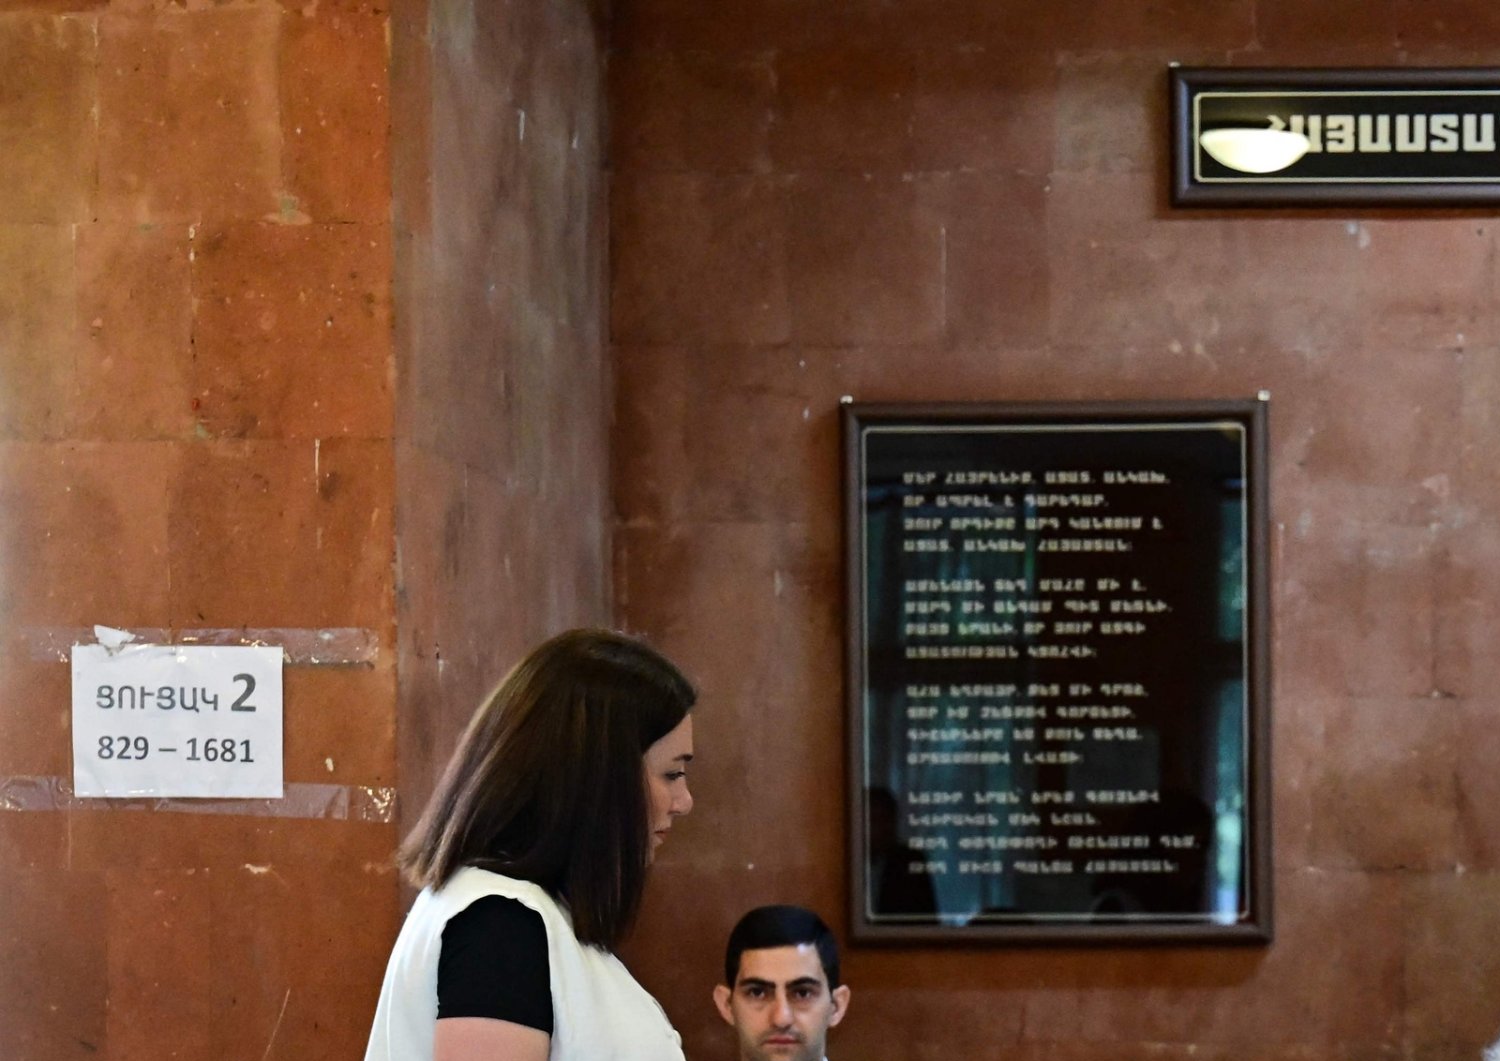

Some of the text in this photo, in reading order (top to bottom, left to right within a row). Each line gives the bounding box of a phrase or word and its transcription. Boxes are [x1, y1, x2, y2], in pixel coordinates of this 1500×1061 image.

[96, 673, 257, 713] ՑՈՒՑԱԿ 2
[97, 736, 150, 761] 829
[186, 738, 255, 763] 1681
